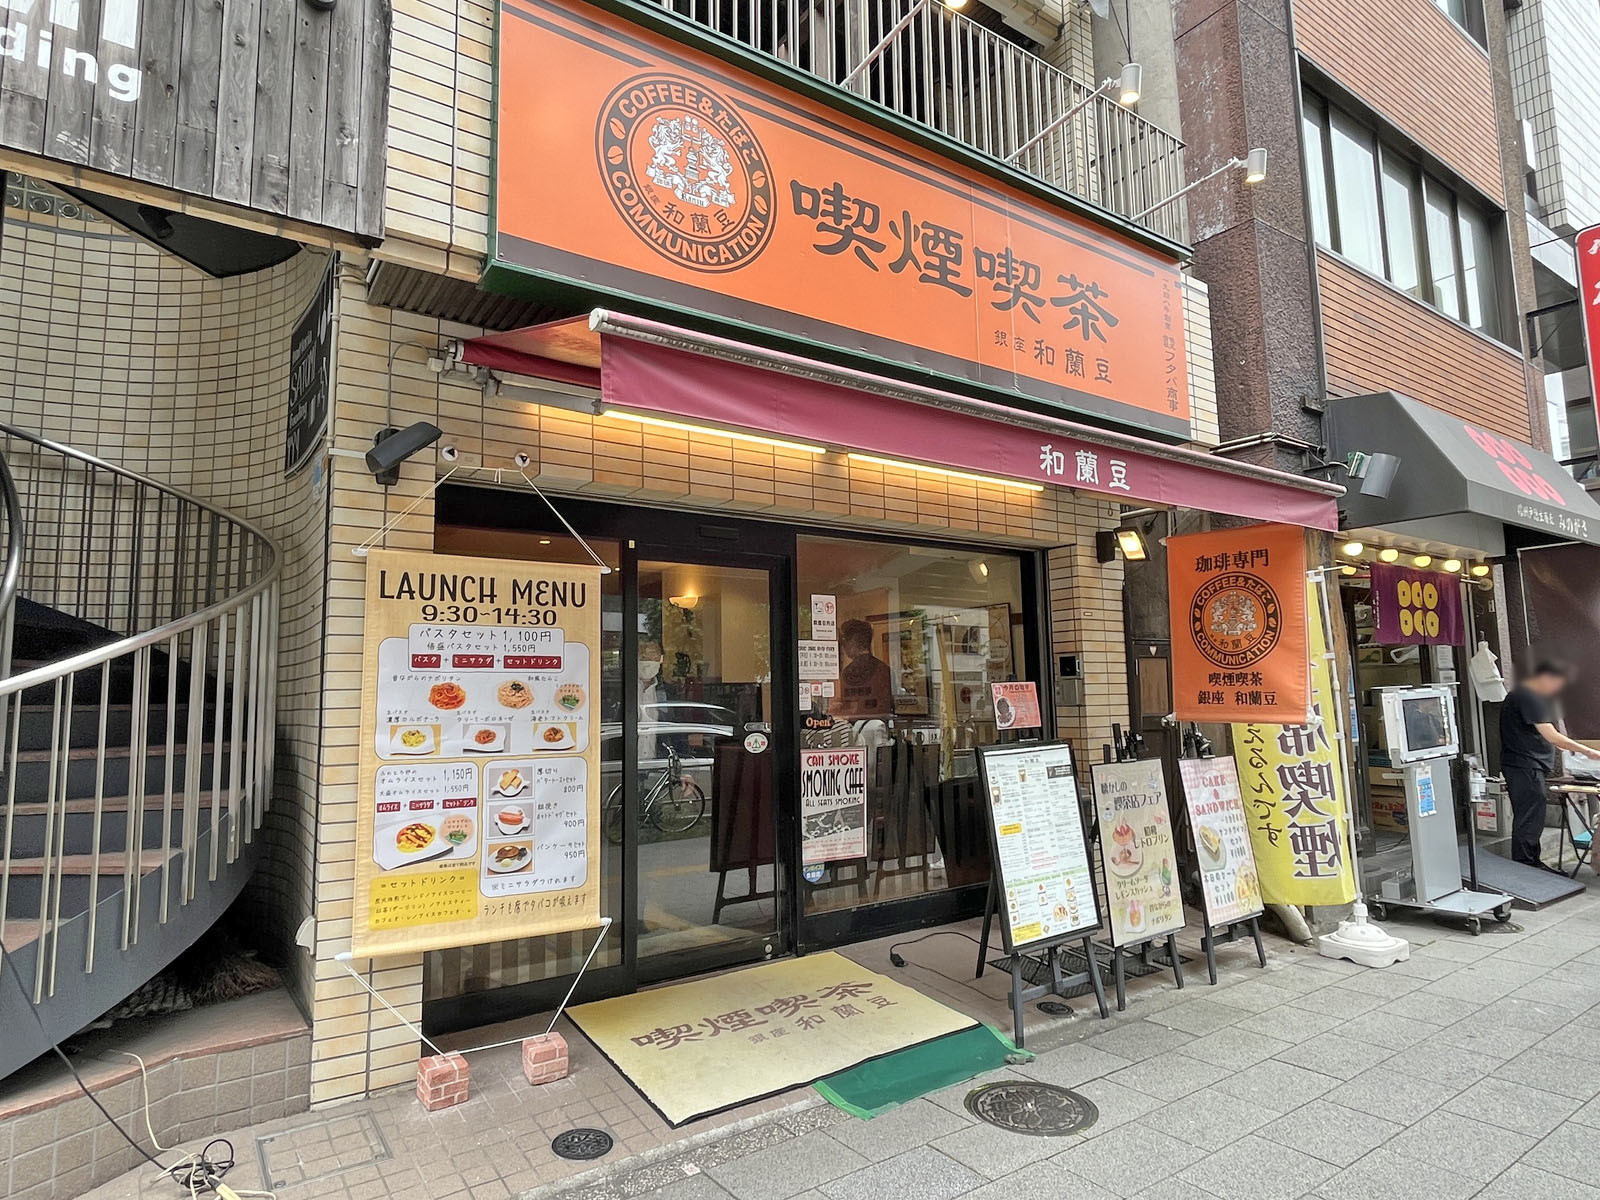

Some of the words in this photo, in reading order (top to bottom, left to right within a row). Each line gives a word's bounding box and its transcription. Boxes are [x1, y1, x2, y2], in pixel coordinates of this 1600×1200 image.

[0, 21, 143, 102] ding
[612, 170, 766, 265] COMMUNICATION
[662, 201, 735, 235] 和蘭豆
[789, 179, 1119, 343] 喫煙喫茶
[993, 329, 1025, 352] 銀座
[1033, 338, 1114, 385] 和蘭豆
[1040, 444, 1131, 491] 和蘭豆
[1194, 548, 1269, 573] 珈琲専門
[379, 570, 498, 604] LAUNCH
[512, 578, 586, 608] MENU
[420, 627, 497, 639] パスタセット
[1196, 629, 1276, 665] COMMUNICATION
[1208, 671, 1263, 687] 喫煙喫茶
[1197, 690, 1225, 705] 銀座
[1234, 690, 1278, 706] 和蘭豆
[805, 717, 831, 729] Open
[806, 755, 824, 767] CAN
[828, 753, 860, 766] SMOKE
[802, 768, 841, 798] SMOKING
[1202, 774, 1226, 788] CAKE
[1194, 798, 1240, 816] SANDWICH
[629, 980, 874, 1051] 喫煙喫茶
[748, 1027, 790, 1046] 銀座
[795, 995, 901, 1033] 和蘭豆
